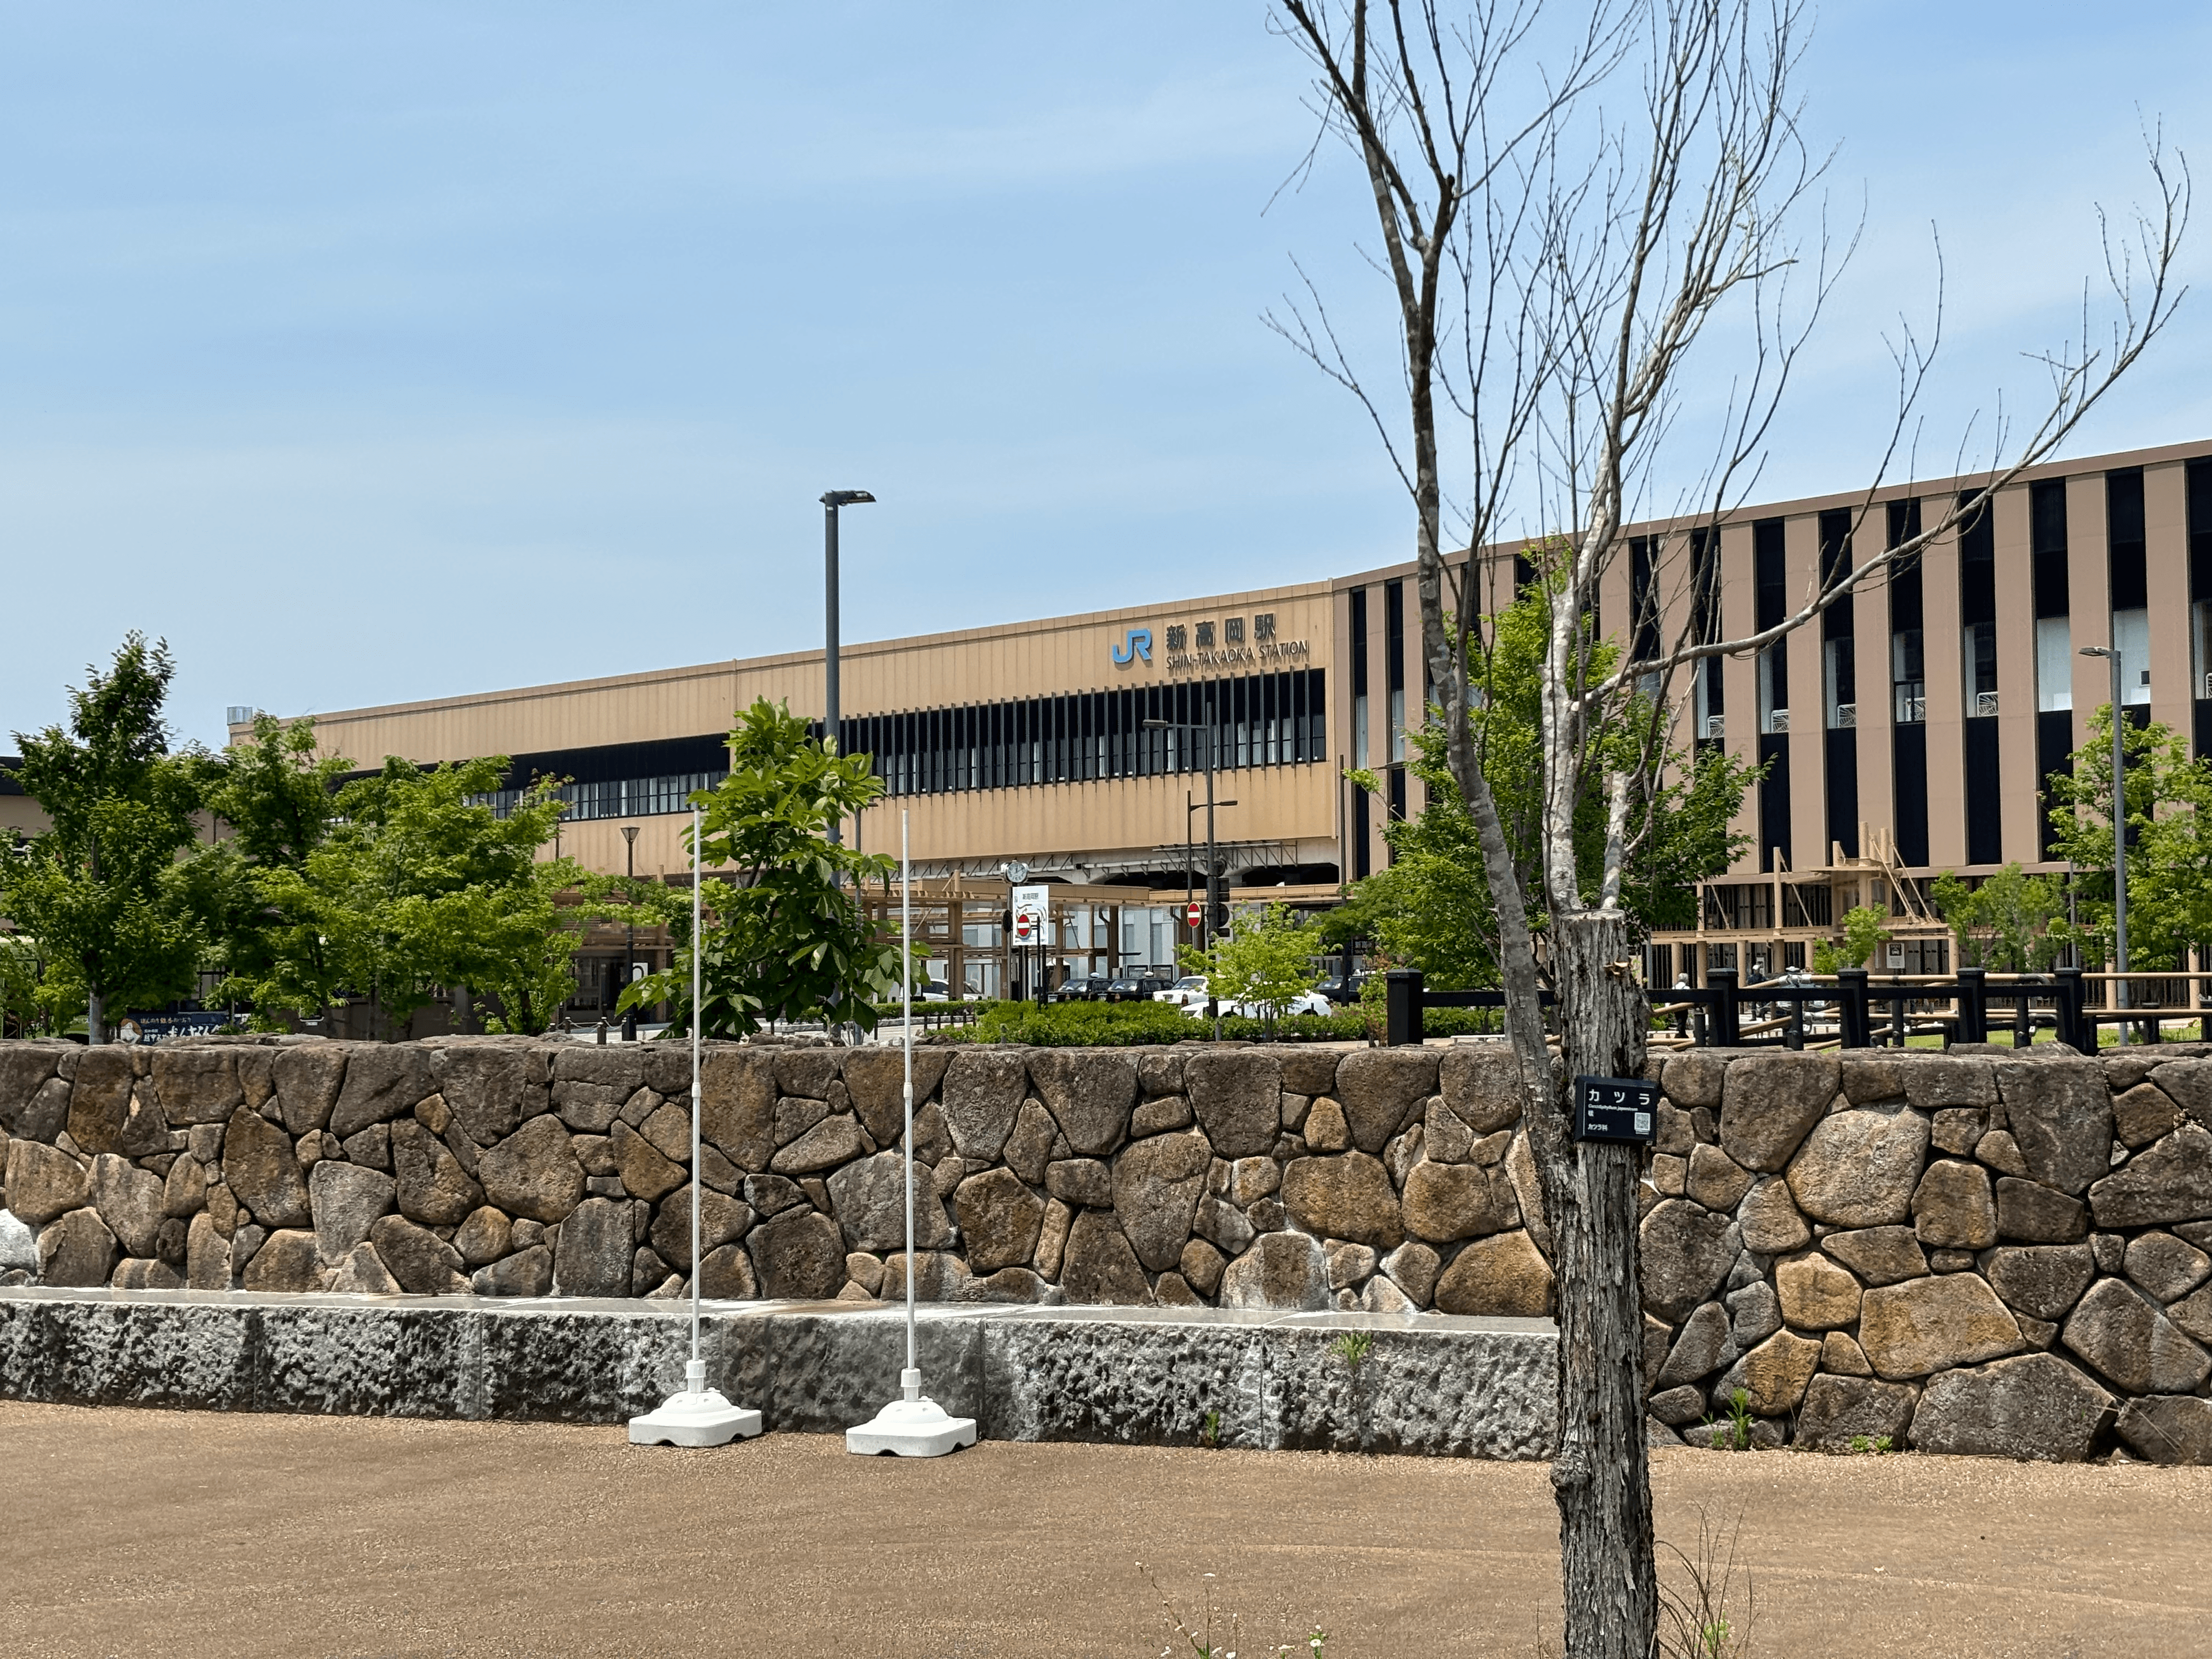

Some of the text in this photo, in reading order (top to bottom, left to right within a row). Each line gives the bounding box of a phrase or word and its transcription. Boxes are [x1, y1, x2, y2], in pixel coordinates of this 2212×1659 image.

[1112, 628, 1152, 664] JR
[1166, 613, 1276, 650] 新高岡駅
[1166, 639, 1309, 670] SHIN-TAKAOKA STATION
[1588, 1089, 1650, 1105] カツラ
